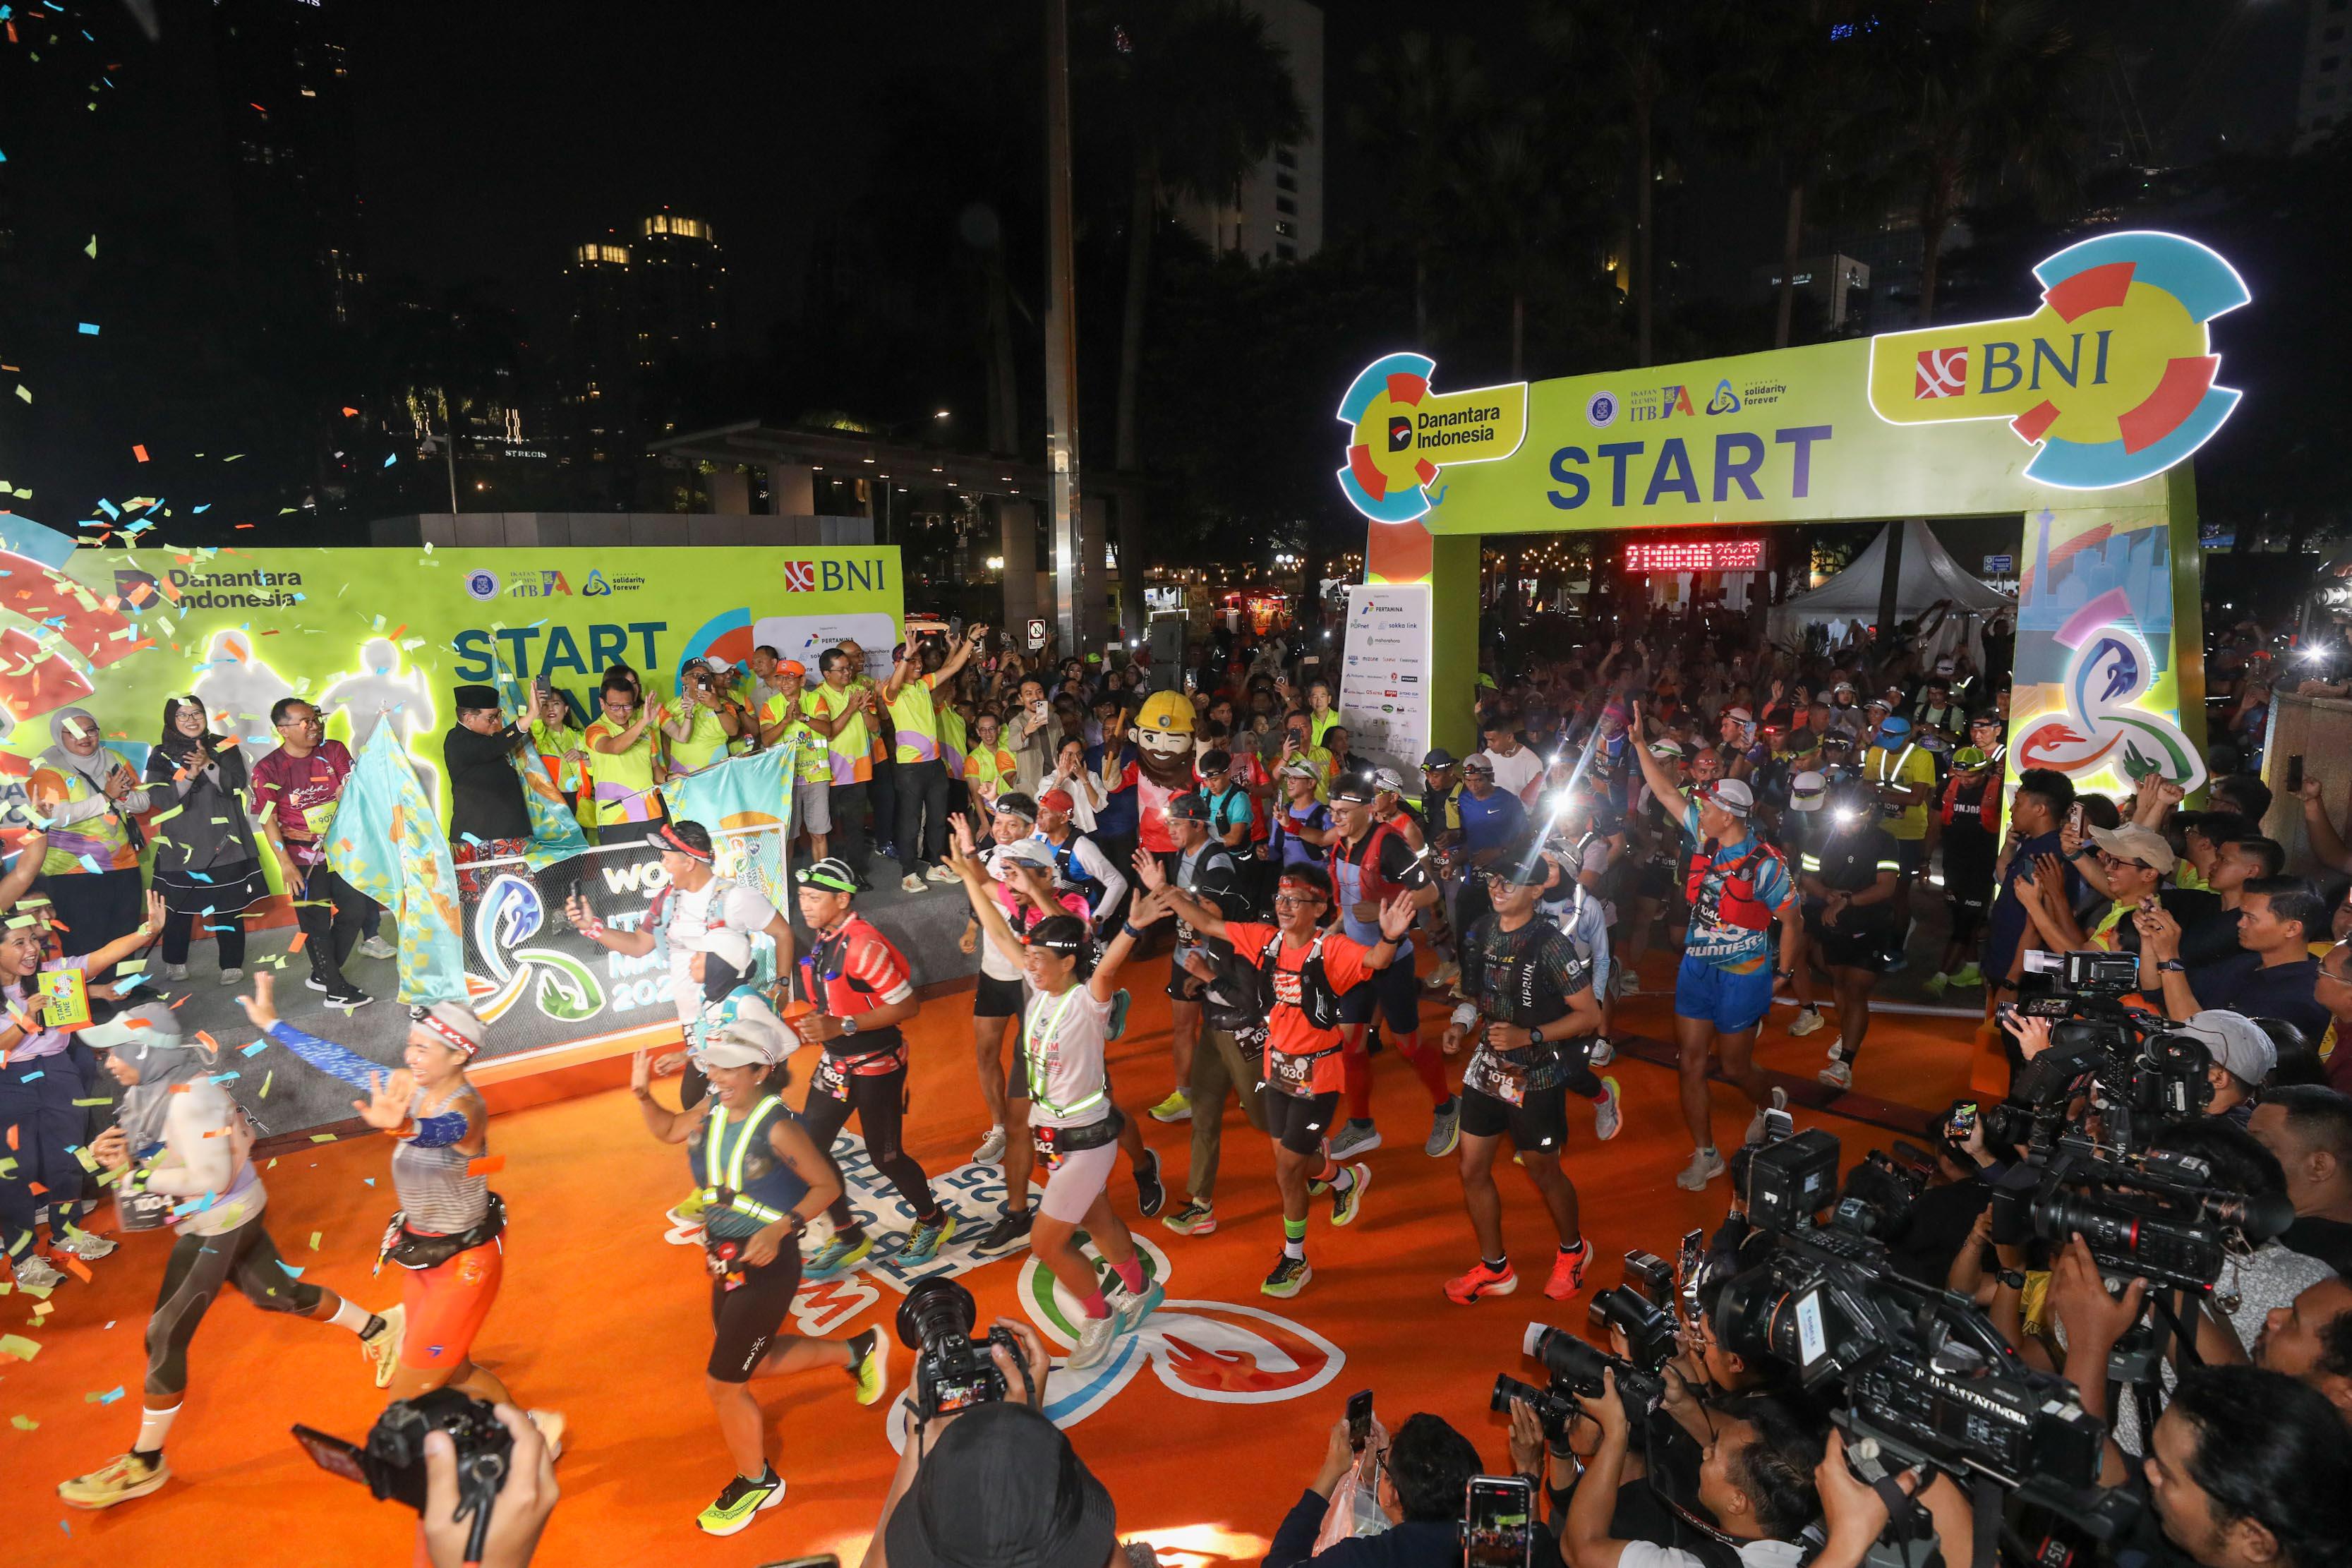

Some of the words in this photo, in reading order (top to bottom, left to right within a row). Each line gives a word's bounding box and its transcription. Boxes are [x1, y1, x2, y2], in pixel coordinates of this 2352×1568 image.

[1979, 330, 2112, 394] BNI
[1744, 384, 1786, 396] solidarity
[1744, 395, 1778, 405] forever
[1418, 405, 1500, 430] Danantara
[1630, 406, 1657, 422] ITB
[1417, 426, 1495, 449] Indonesia
[1546, 424, 1833, 509] START
[169, 568, 301, 589] Danantara
[821, 560, 885, 591] BNI
[176, 588, 297, 609] Indonesia
[512, 584, 538, 598] ITB
[454, 621, 668, 682] START
[1883, 802, 1900, 812] 1019
[1661, 857, 1677, 867] 1018
[612, 975, 675, 1012] 202
[1521, 963, 1534, 1008] KIPRUN
[56, 1001, 65, 1020] START
[63, 1001, 72, 1016] LINE
[1250, 1028, 1270, 1044] 103
[1279, 1065, 1305, 1080] 1030
[1488, 1070, 1514, 1087] 1014
